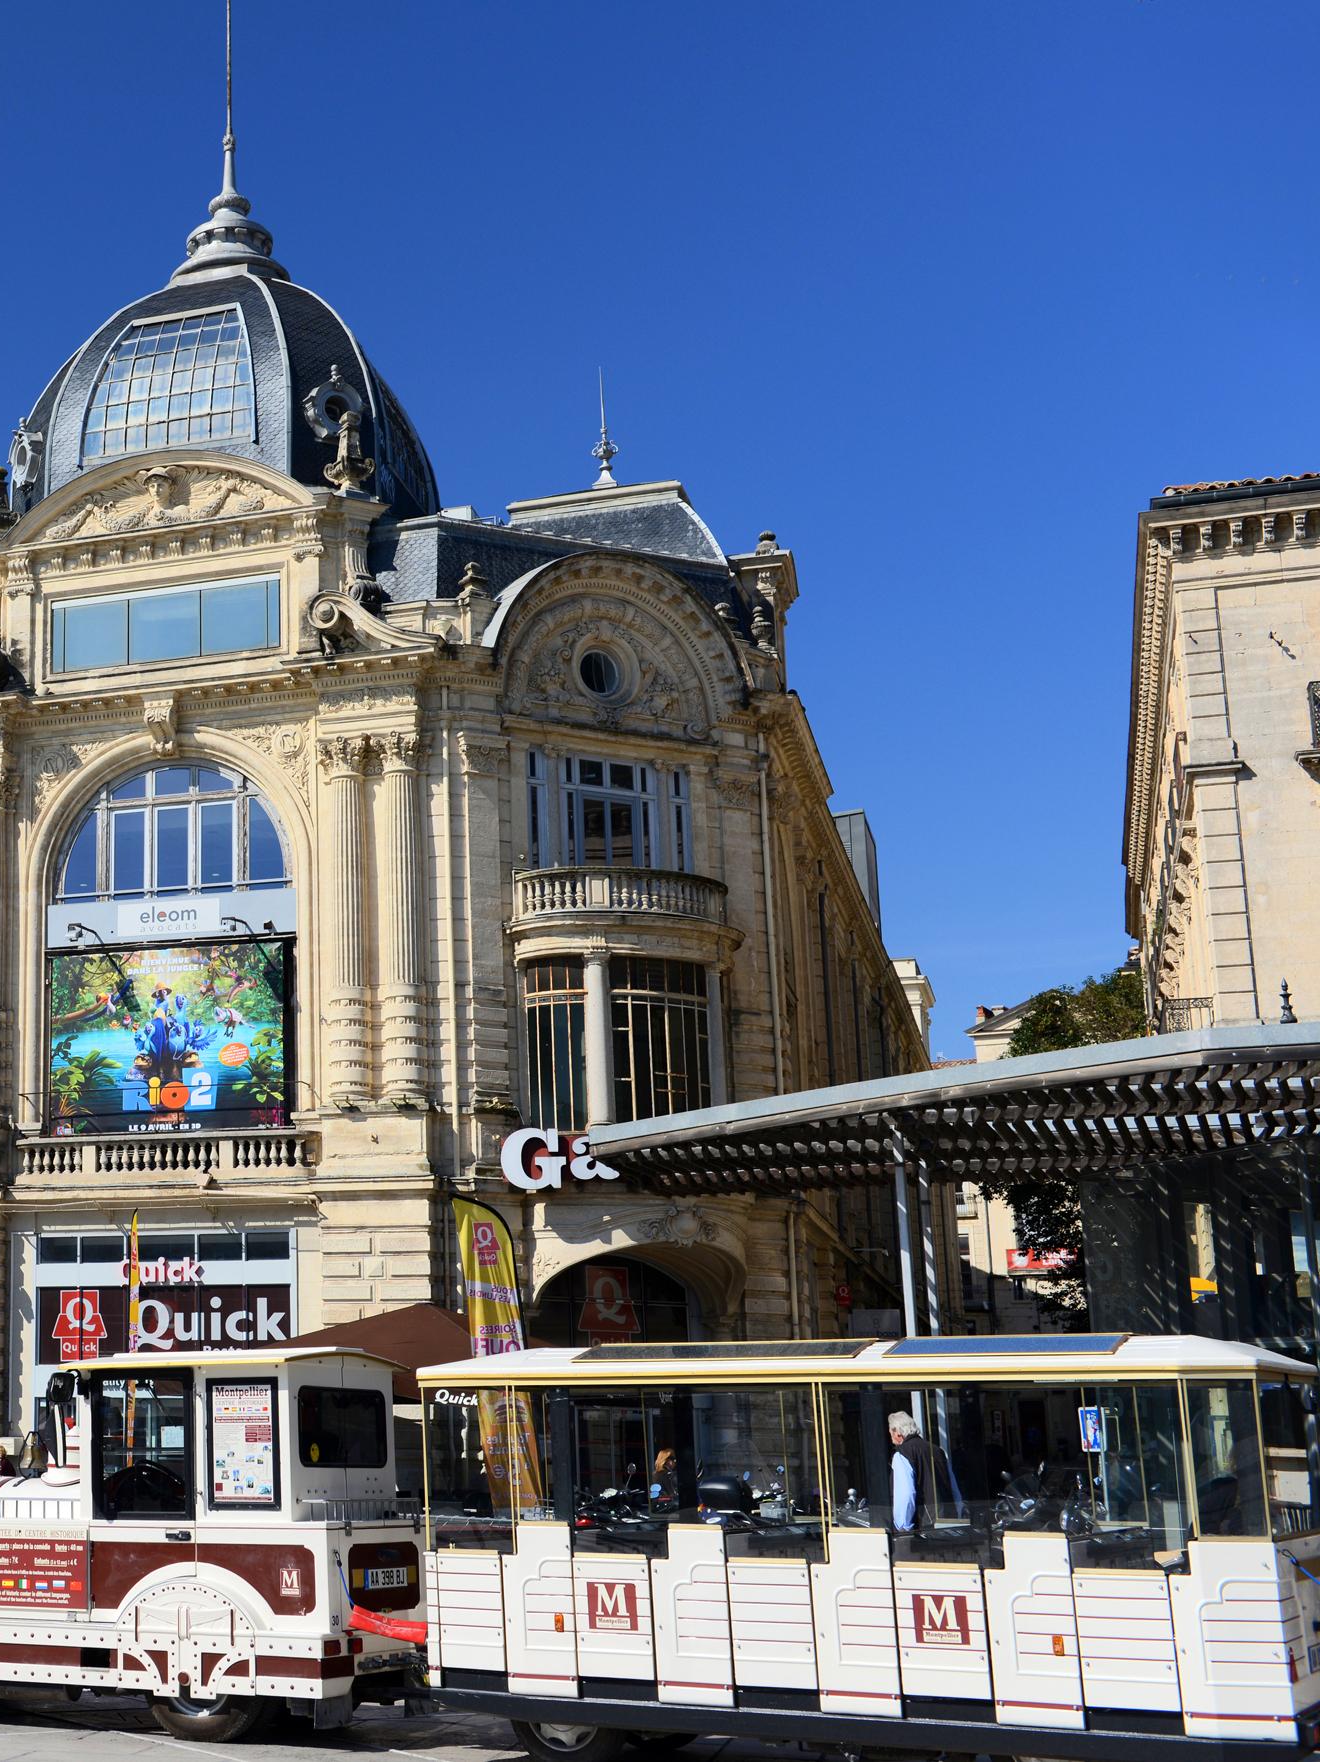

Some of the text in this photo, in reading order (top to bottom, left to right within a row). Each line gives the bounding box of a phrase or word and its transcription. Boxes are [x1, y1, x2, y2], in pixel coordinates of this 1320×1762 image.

[140, 906, 197, 923] eleom
[166, 963, 199, 973] JUNGLE
[190, 1071, 212, 1106] 2
[128, 1124, 139, 1132] LE
[147, 1123, 174, 1131] AVRIL
[66, 1297, 96, 1332] Q
[137, 1296, 287, 1350] Quick
[63, 1342, 97, 1354] Quick
[215, 1386, 269, 1399] Montpellier
[434, 1389, 478, 1405] Quick
[25, 1529, 47, 1537] CENTRE
[50, 1530, 85, 1539] HISTORIQUE
[281, 1570, 299, 1588] M
[370, 1569, 380, 1586] AA
[381, 1568, 394, 1586] 398
[594, 1583, 630, 1616] M
[331, 1615, 340, 1626] 30
[920, 1595, 961, 1630] M
[597, 1617, 629, 1625] Montpellier
[925, 1631, 959, 1639] Montpellier
